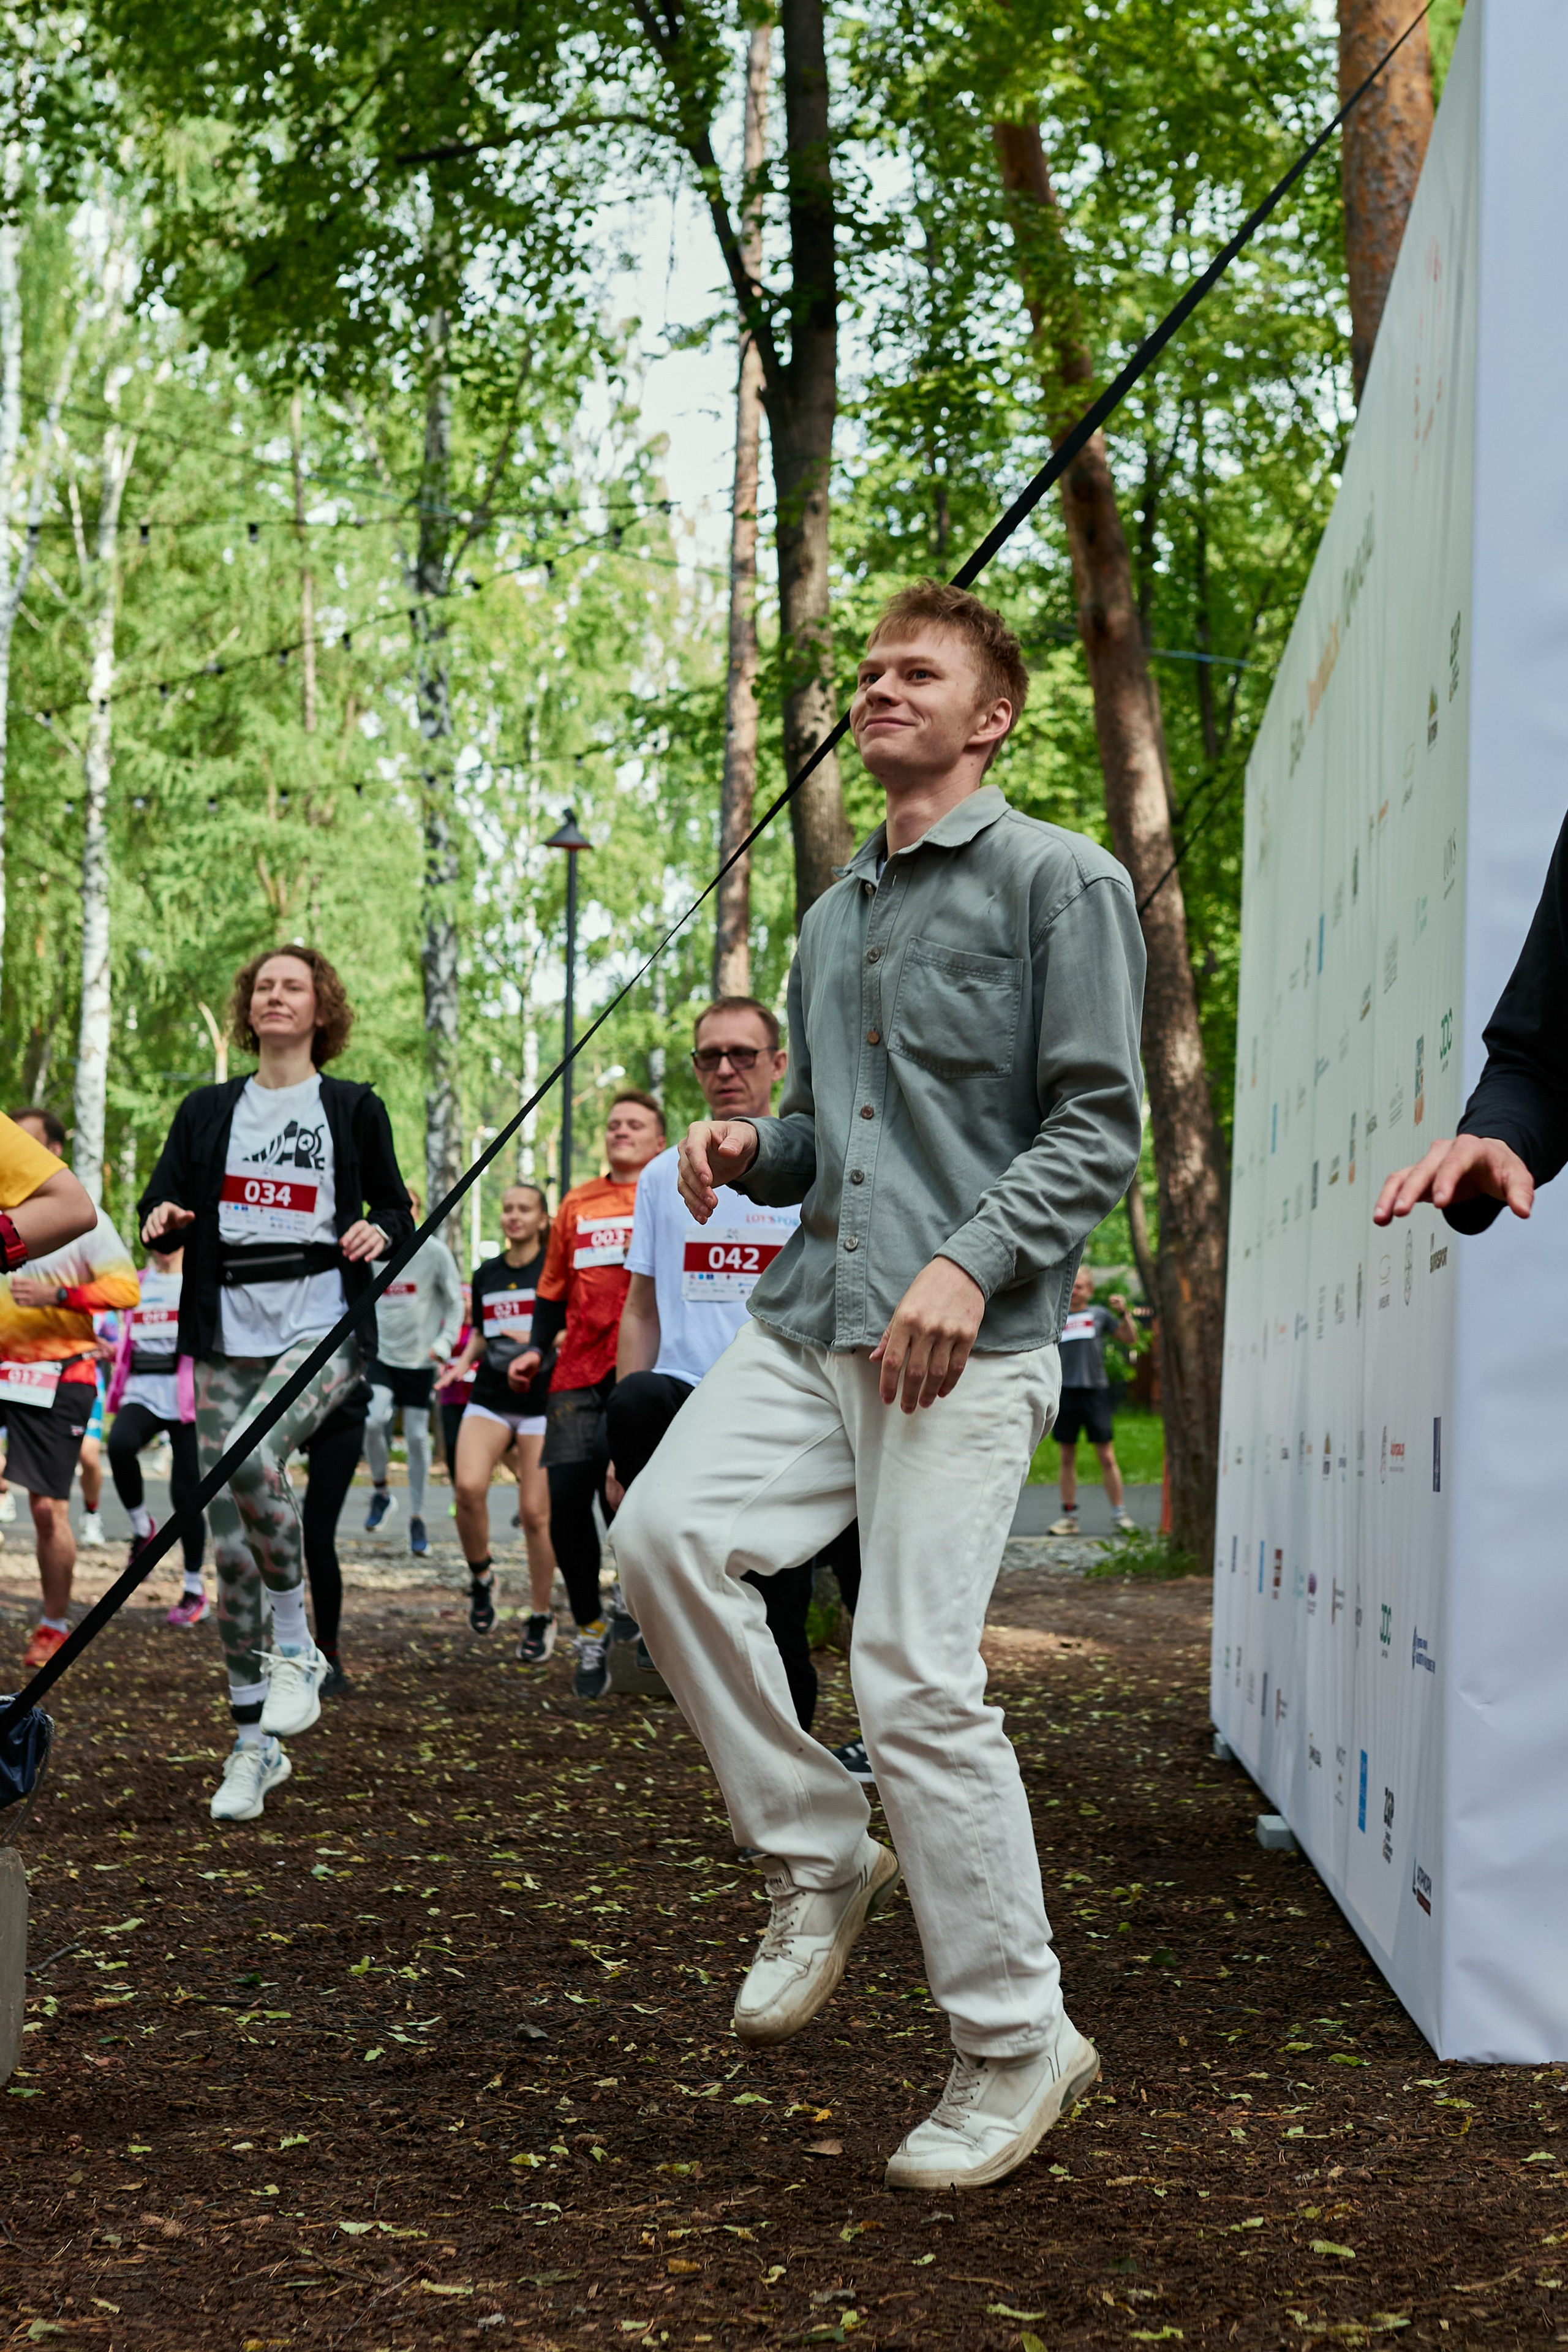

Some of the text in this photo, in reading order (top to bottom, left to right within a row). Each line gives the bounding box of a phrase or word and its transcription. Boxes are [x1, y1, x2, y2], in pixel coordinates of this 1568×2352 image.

[244, 1180, 292, 1207] 034
[591, 1228, 625, 1247] 003
[708, 1246, 760, 1270] 042
[8, 1368, 42, 1386] 017
